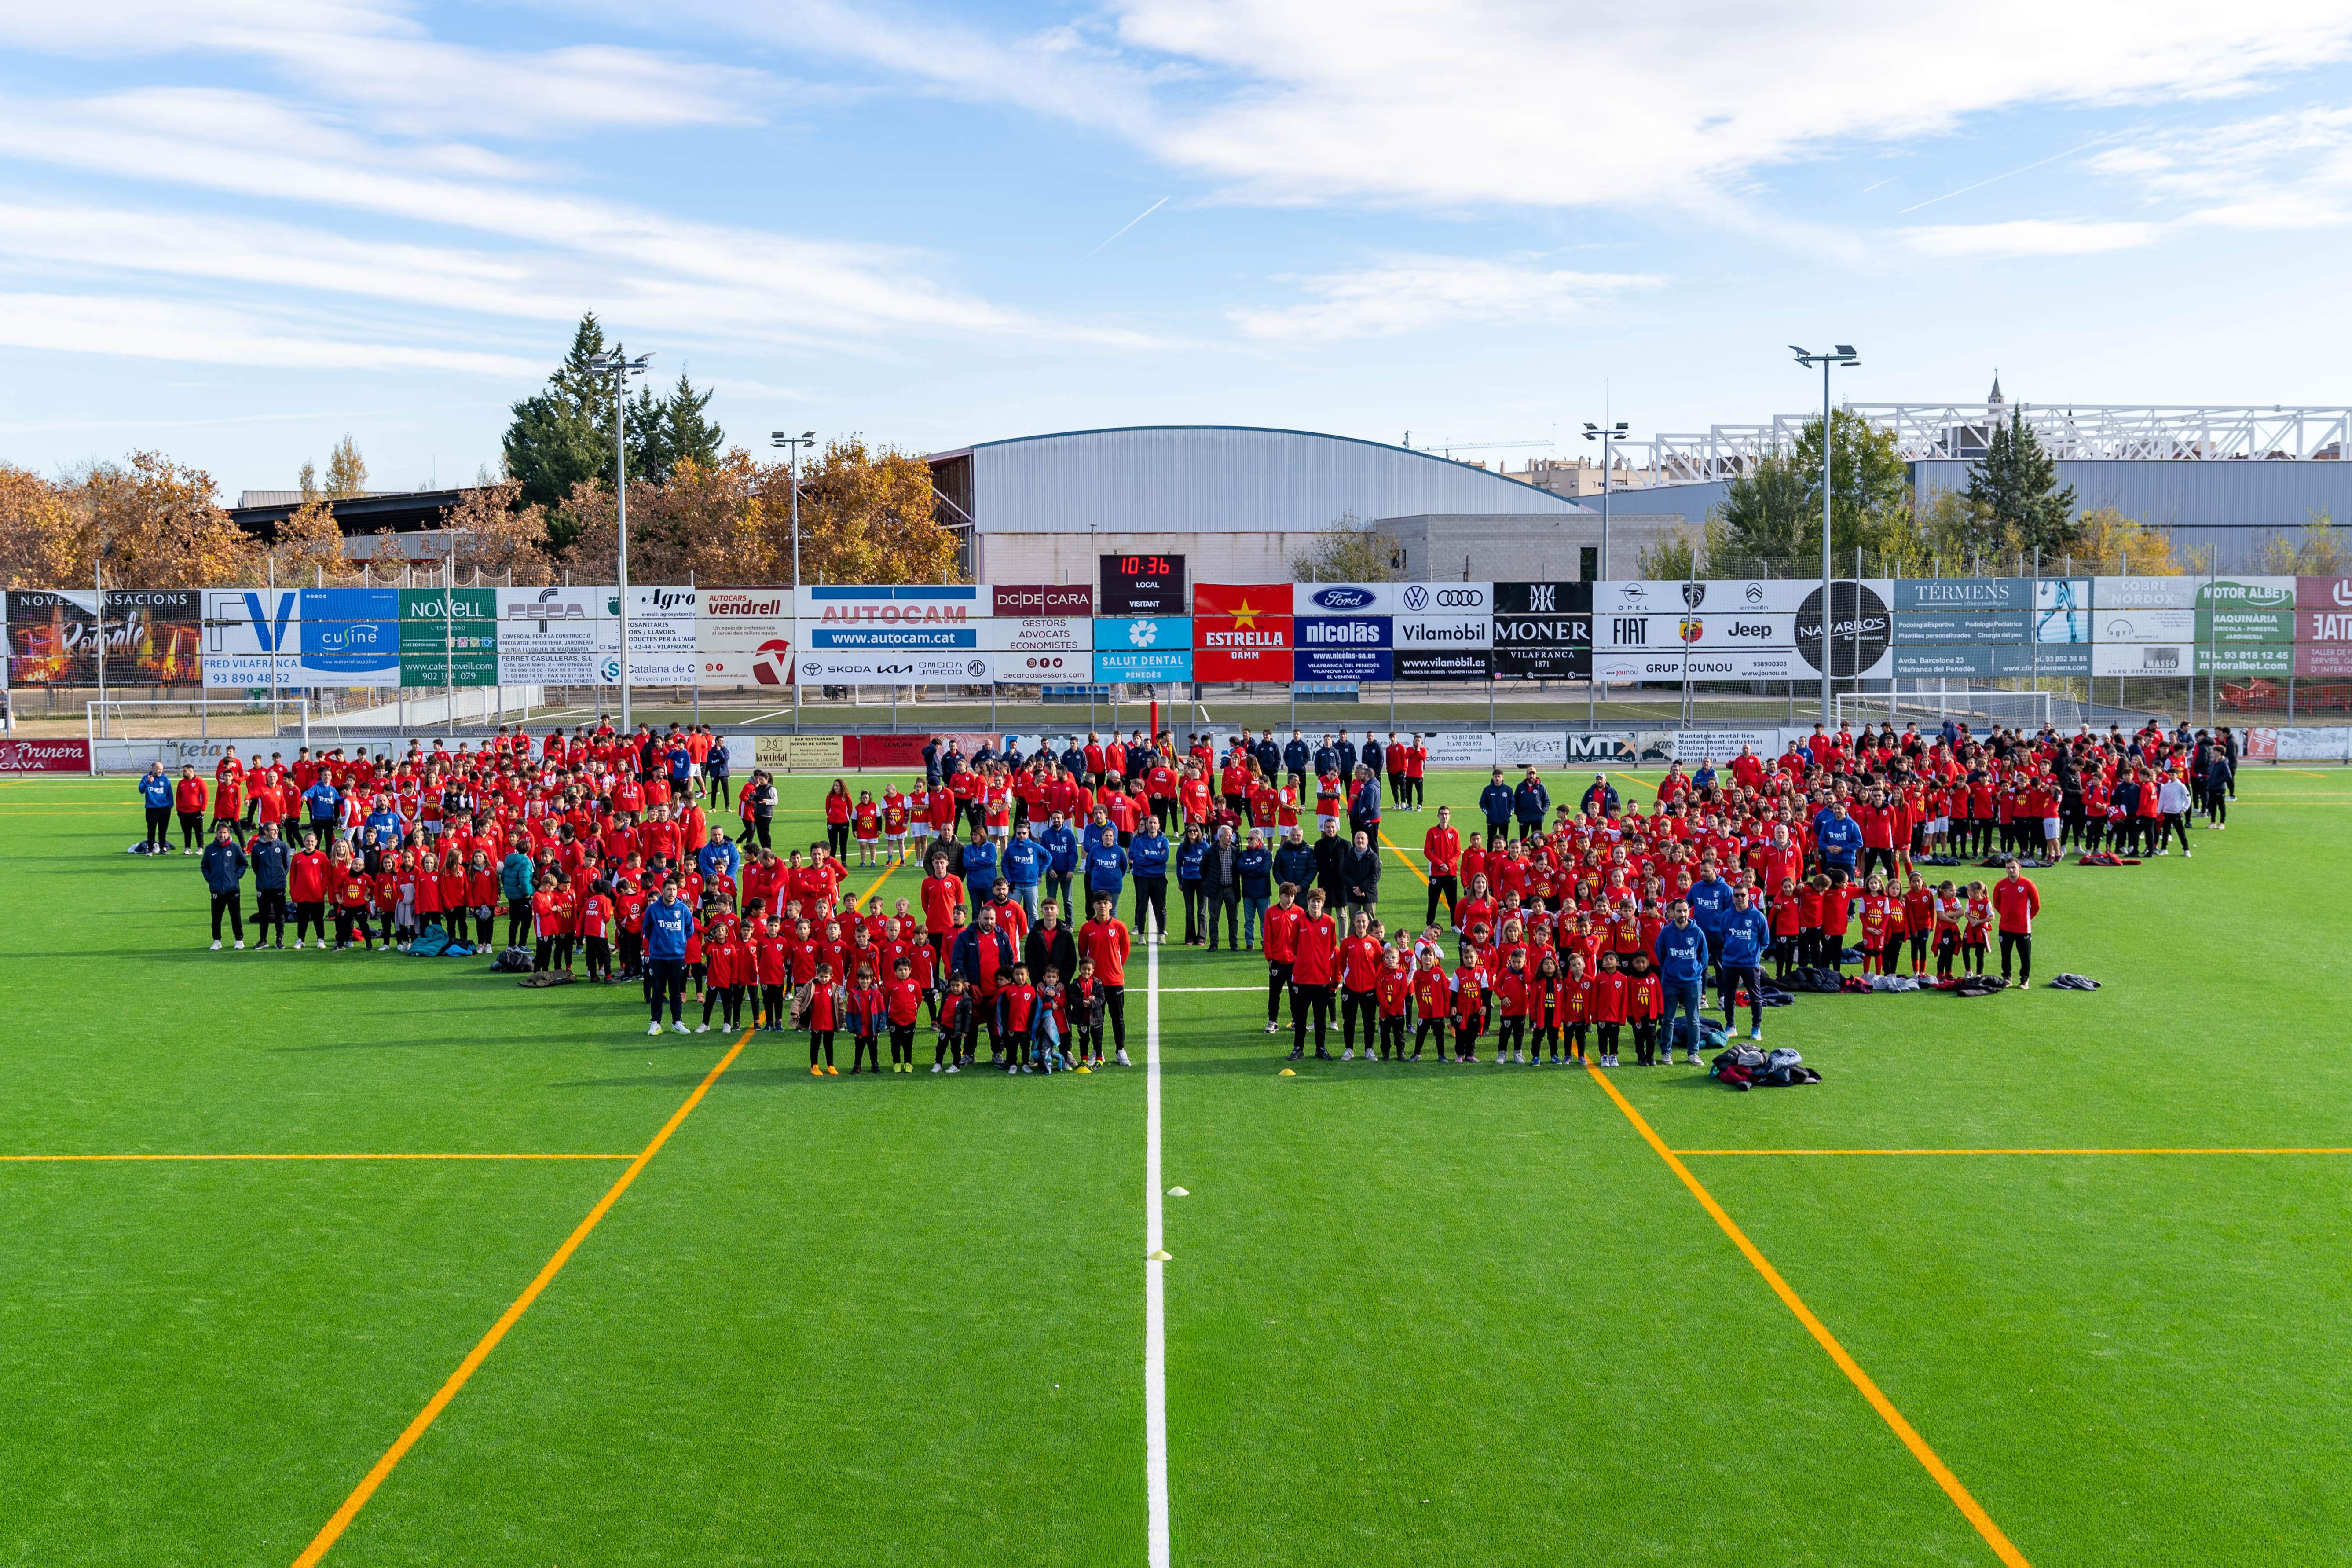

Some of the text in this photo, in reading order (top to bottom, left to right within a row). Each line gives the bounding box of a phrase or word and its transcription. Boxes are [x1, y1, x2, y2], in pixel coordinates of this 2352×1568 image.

[641, 589, 696, 610] Agro
[1047, 594, 1089, 604] CARA
[1324, 591, 1363, 606] Ford
[2204, 587, 2286, 599] MOTOR ALBET
[103, 594, 187, 606] NSACIONS
[709, 600, 780, 615] vendrell
[821, 606, 966, 624] AUTOCAM
[1403, 623, 1485, 640] Vilamòbil
[1495, 622, 1590, 640] MONER
[1613, 618, 1648, 644] FIAT
[1728, 622, 1772, 639] Jeep
[832, 633, 955, 644] www.autocam.cat
[1206, 632, 1283, 647] ESTRELLA
[1102, 656, 1183, 666] SALUT DENTAL
[1403, 656, 1485, 667] www.vilamòbil.es
[628, 664, 696, 673] Catalana de C
[1646, 663, 1733, 673] GRUP OUNOU
[213, 674, 227, 683] 93
[231, 674, 253, 683] 890
[15, 743, 84, 759] Prunera
[764, 753, 787, 761] societat
